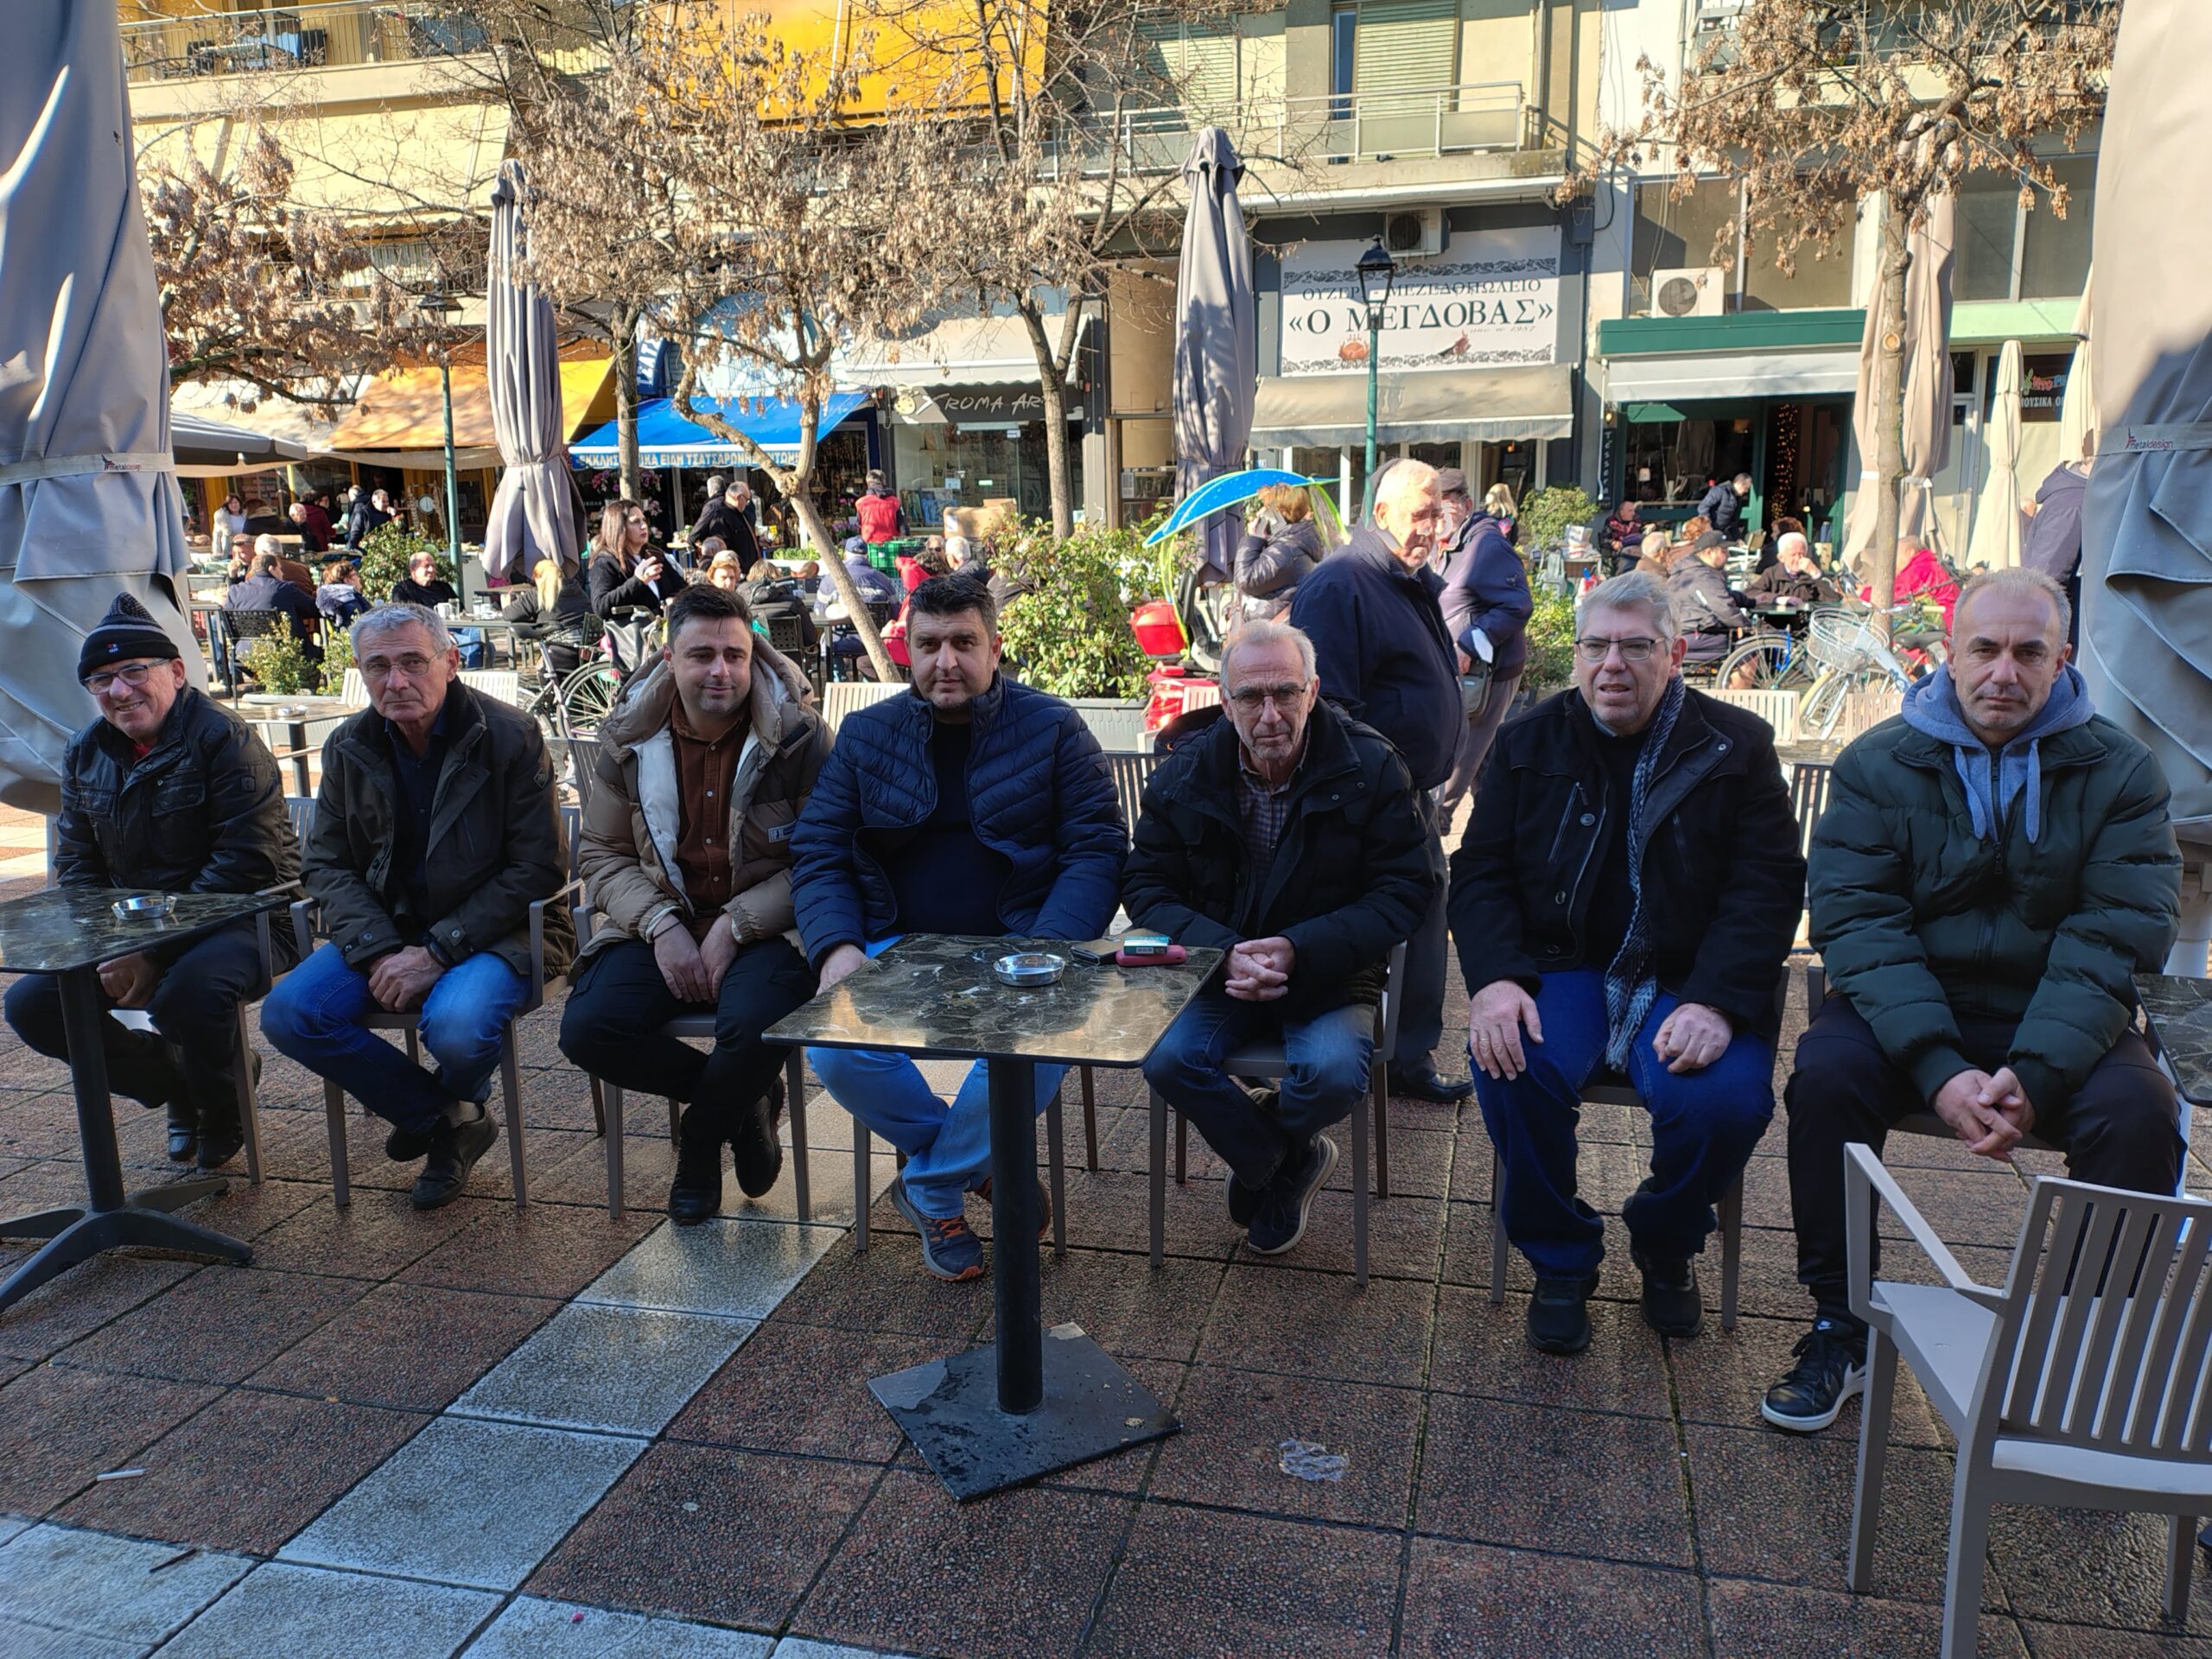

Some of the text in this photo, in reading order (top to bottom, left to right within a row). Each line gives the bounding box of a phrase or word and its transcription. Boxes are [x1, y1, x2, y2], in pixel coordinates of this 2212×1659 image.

[1302, 286, 1363, 301] ΟΥΖΕΡ
[1387, 278, 1541, 297] ΜΕΖΕΔΟΠΩΛΕΙΟ
[1011, 392, 1045, 416] AR
[2055, 396, 2065, 407] Ο
[2130, 439, 2173, 451] metaldesign
